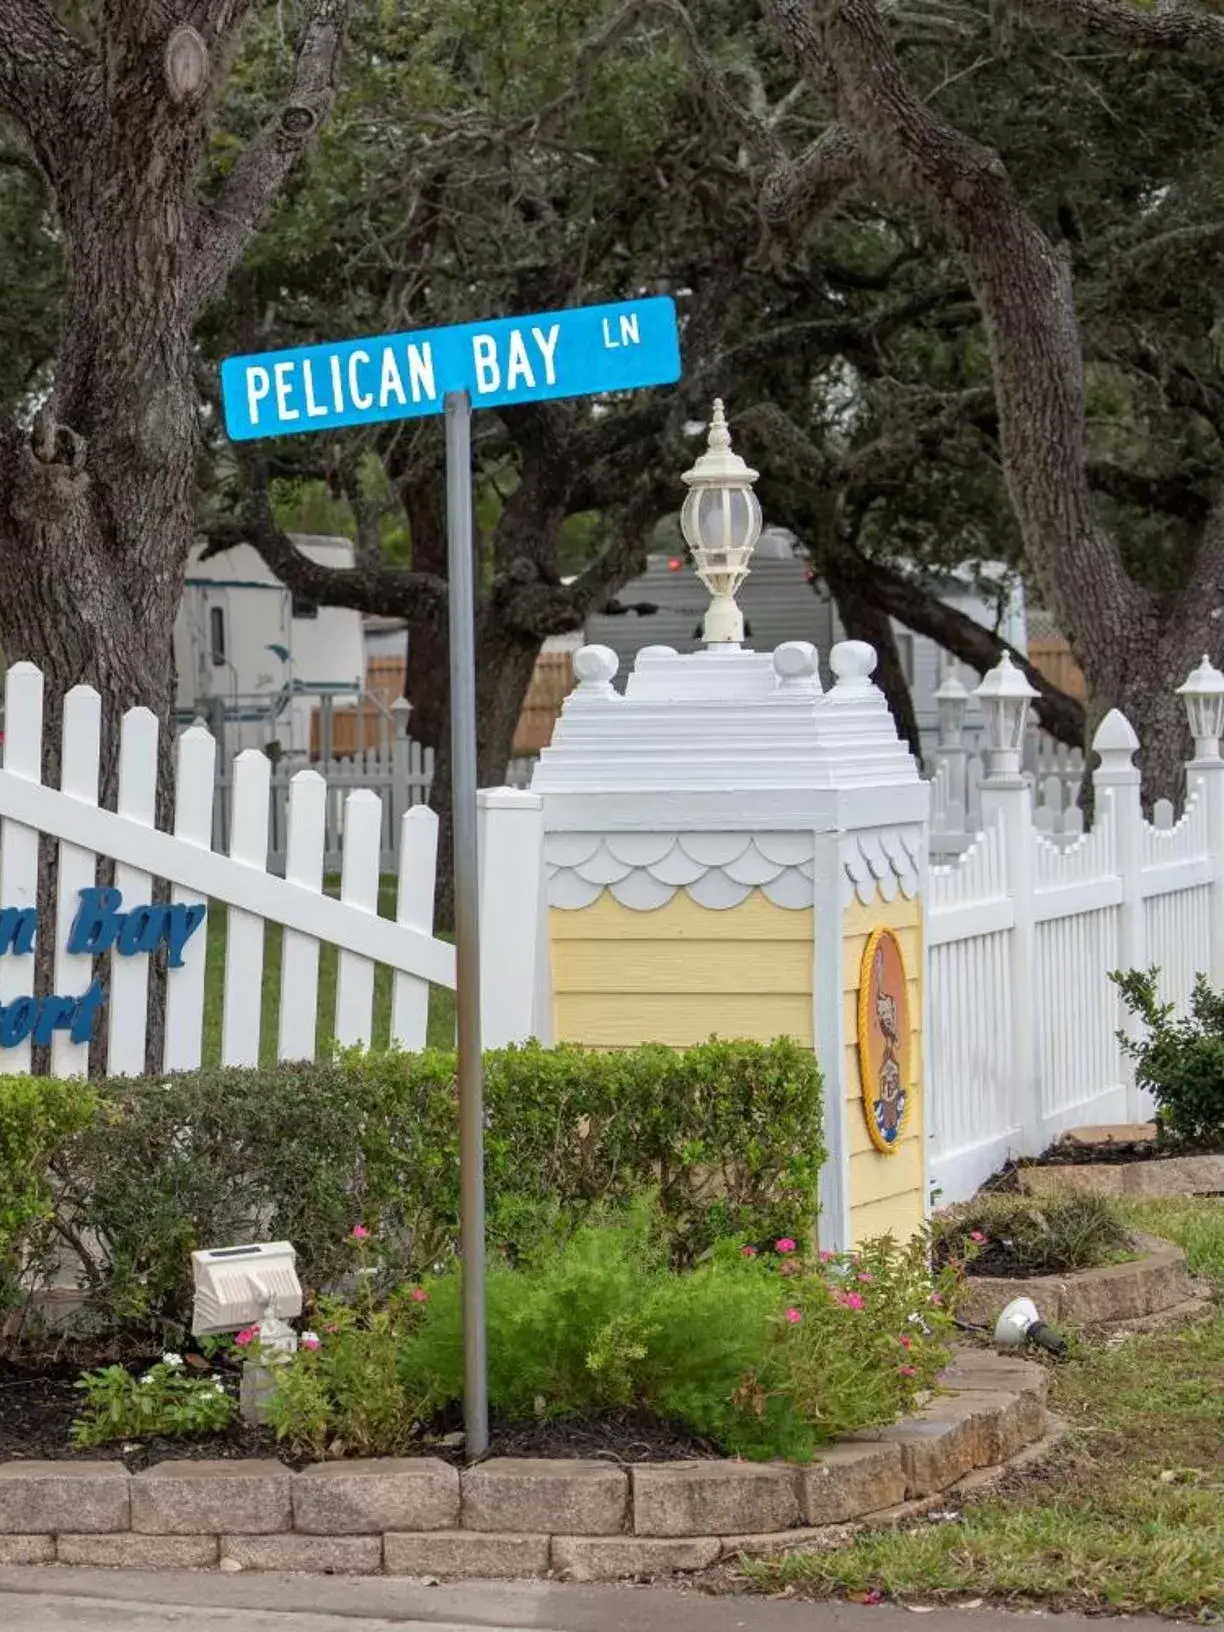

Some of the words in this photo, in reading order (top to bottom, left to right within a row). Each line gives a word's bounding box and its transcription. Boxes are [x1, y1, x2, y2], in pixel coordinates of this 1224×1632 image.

[245, 341, 437, 425] PELICAN
[472, 324, 561, 394] BAY
[602, 313, 640, 349] LN
[66, 887, 206, 969] Bay
